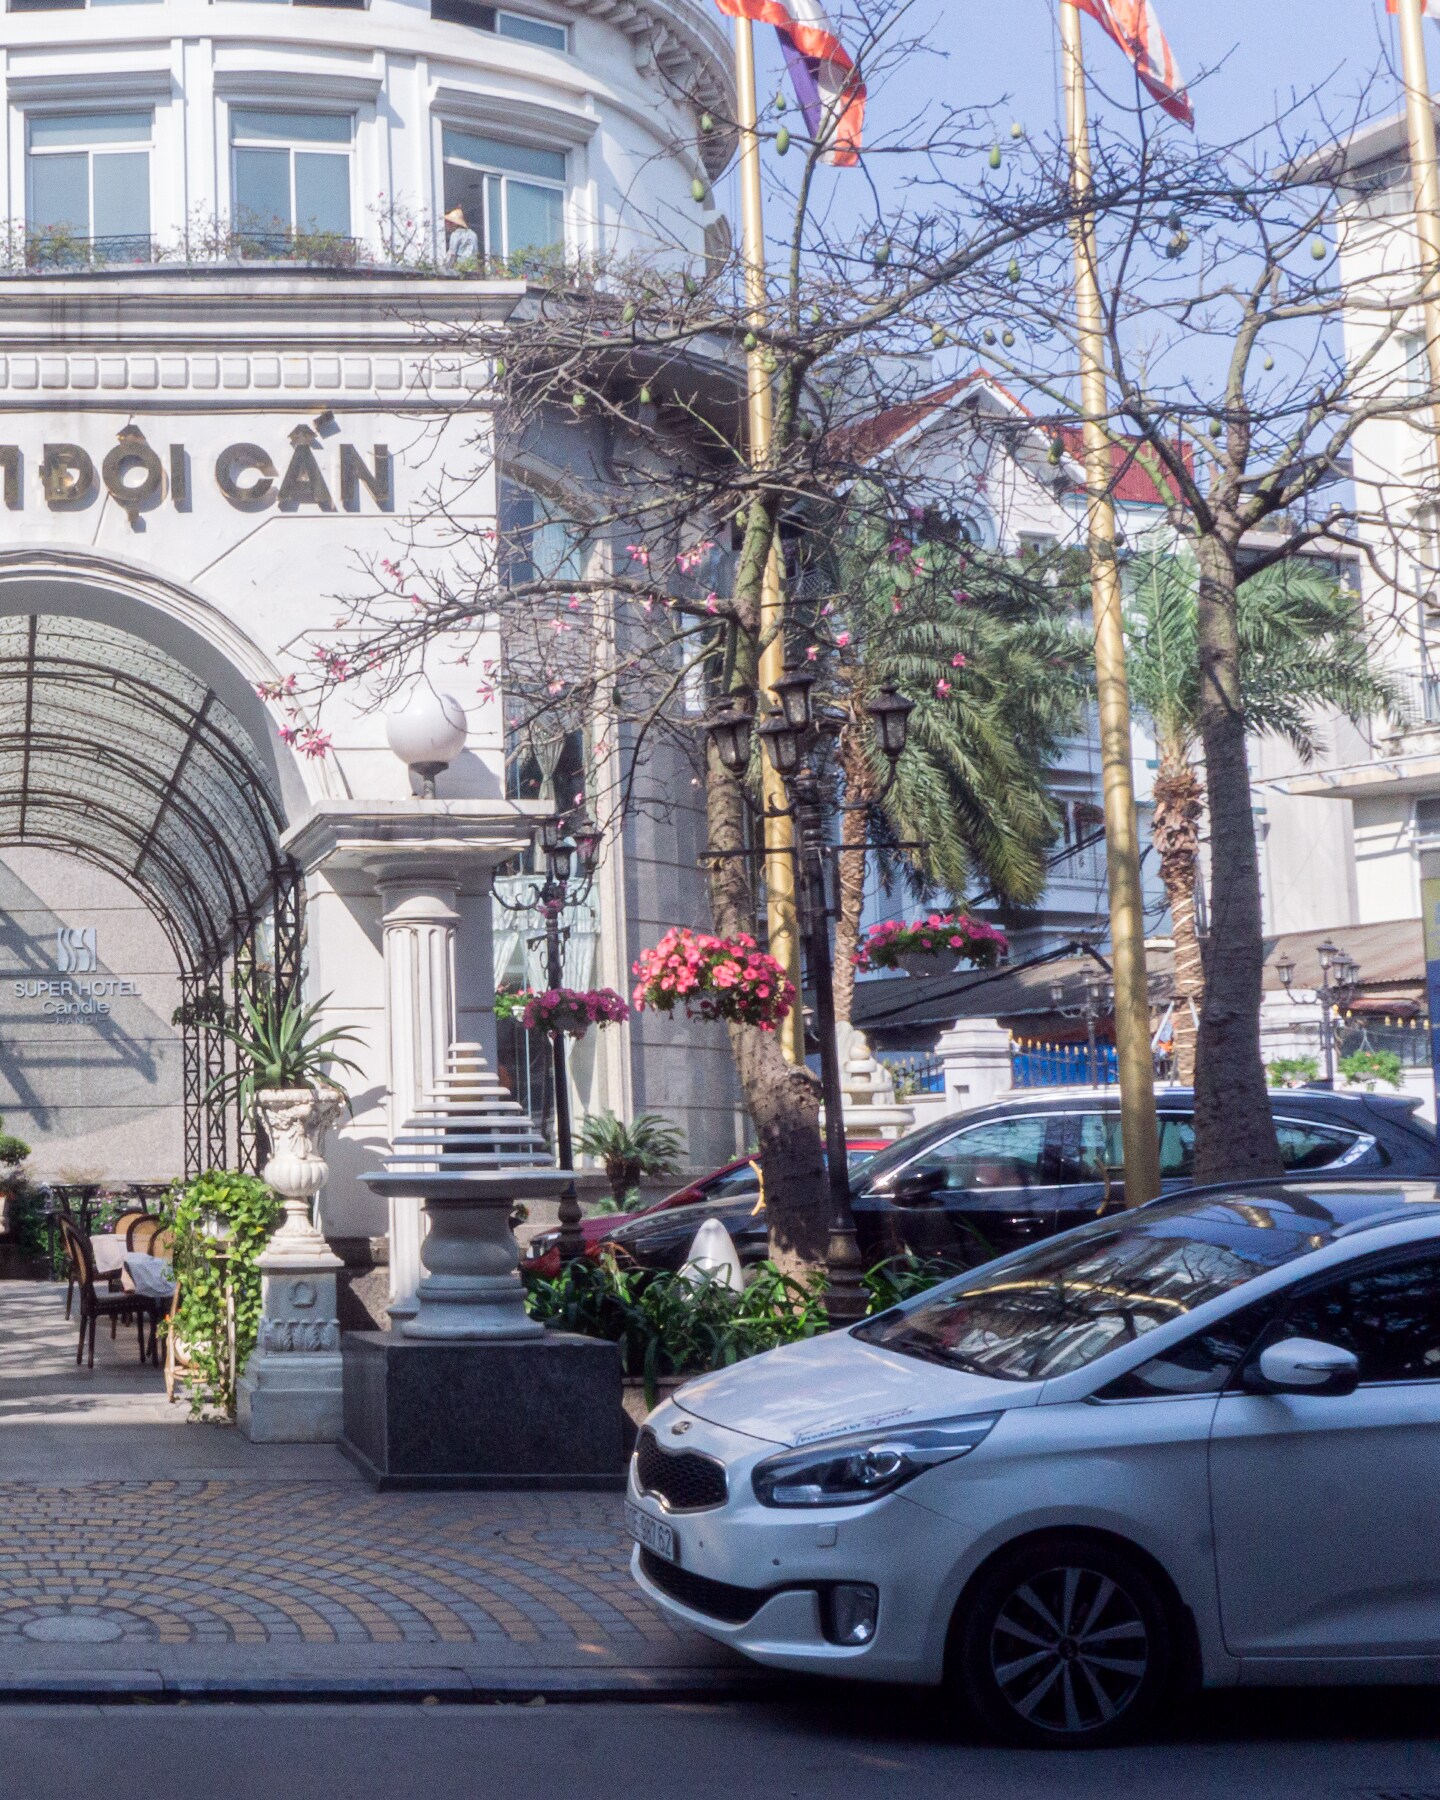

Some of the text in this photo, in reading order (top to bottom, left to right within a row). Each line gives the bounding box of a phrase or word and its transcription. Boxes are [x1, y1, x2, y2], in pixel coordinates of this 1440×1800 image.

[13, 980, 142, 998] SUPER HOTEL
[42, 1000, 111, 1015] Candle
